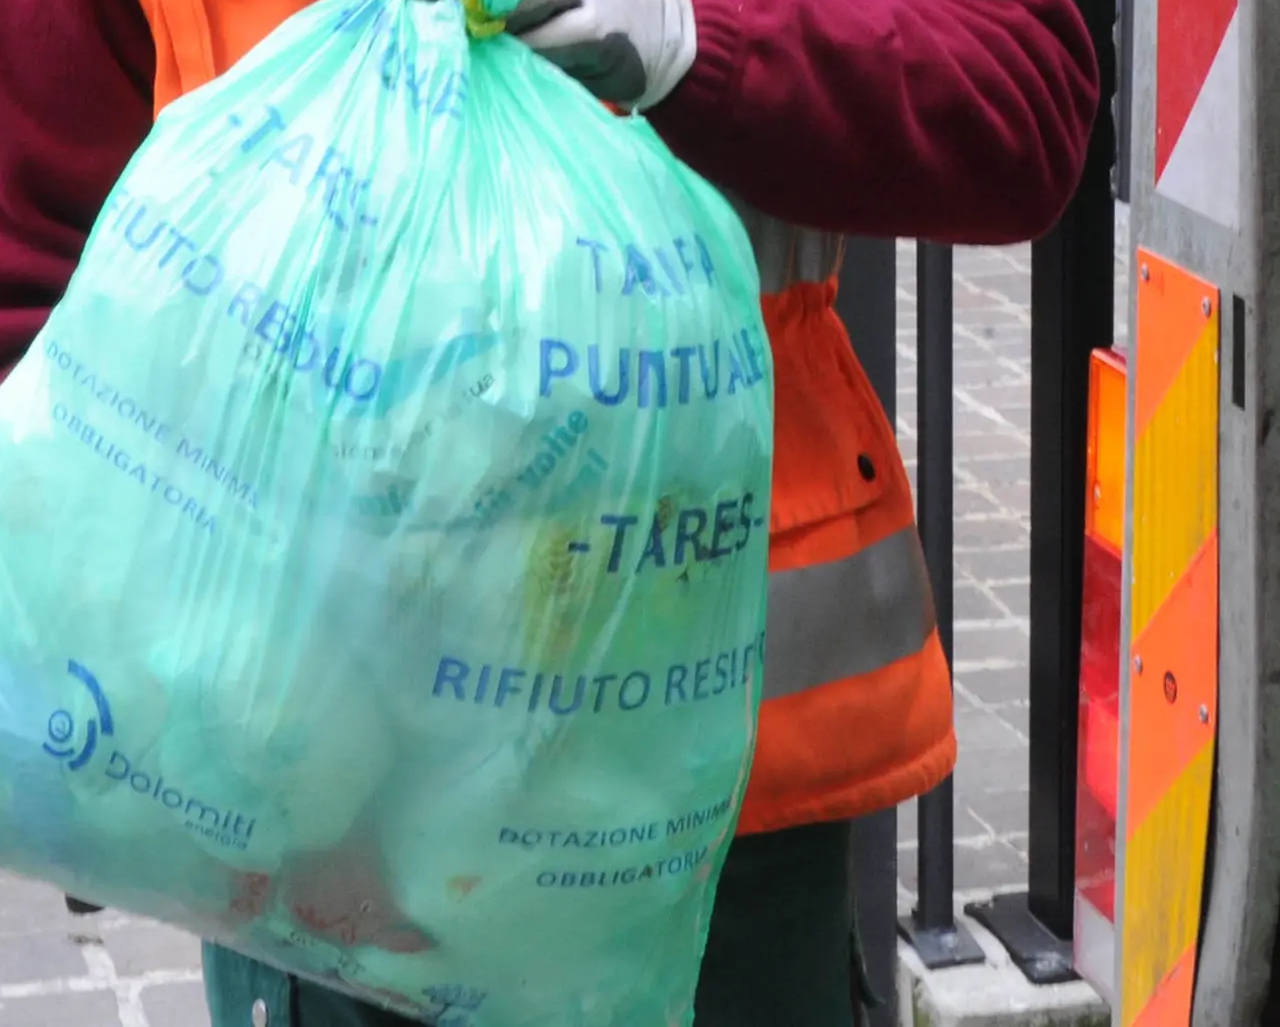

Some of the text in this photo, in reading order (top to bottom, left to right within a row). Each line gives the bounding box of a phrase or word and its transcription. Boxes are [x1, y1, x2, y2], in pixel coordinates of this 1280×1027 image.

[46, 339, 171, 441] DOTAZIONE
[52, 402, 218, 535] OBBLIGATORIA
[431, 655, 651, 717] RIFIUTO
[104, 750, 257, 839] Dolomiti
[498, 823, 661, 851] DOTAZIONE
